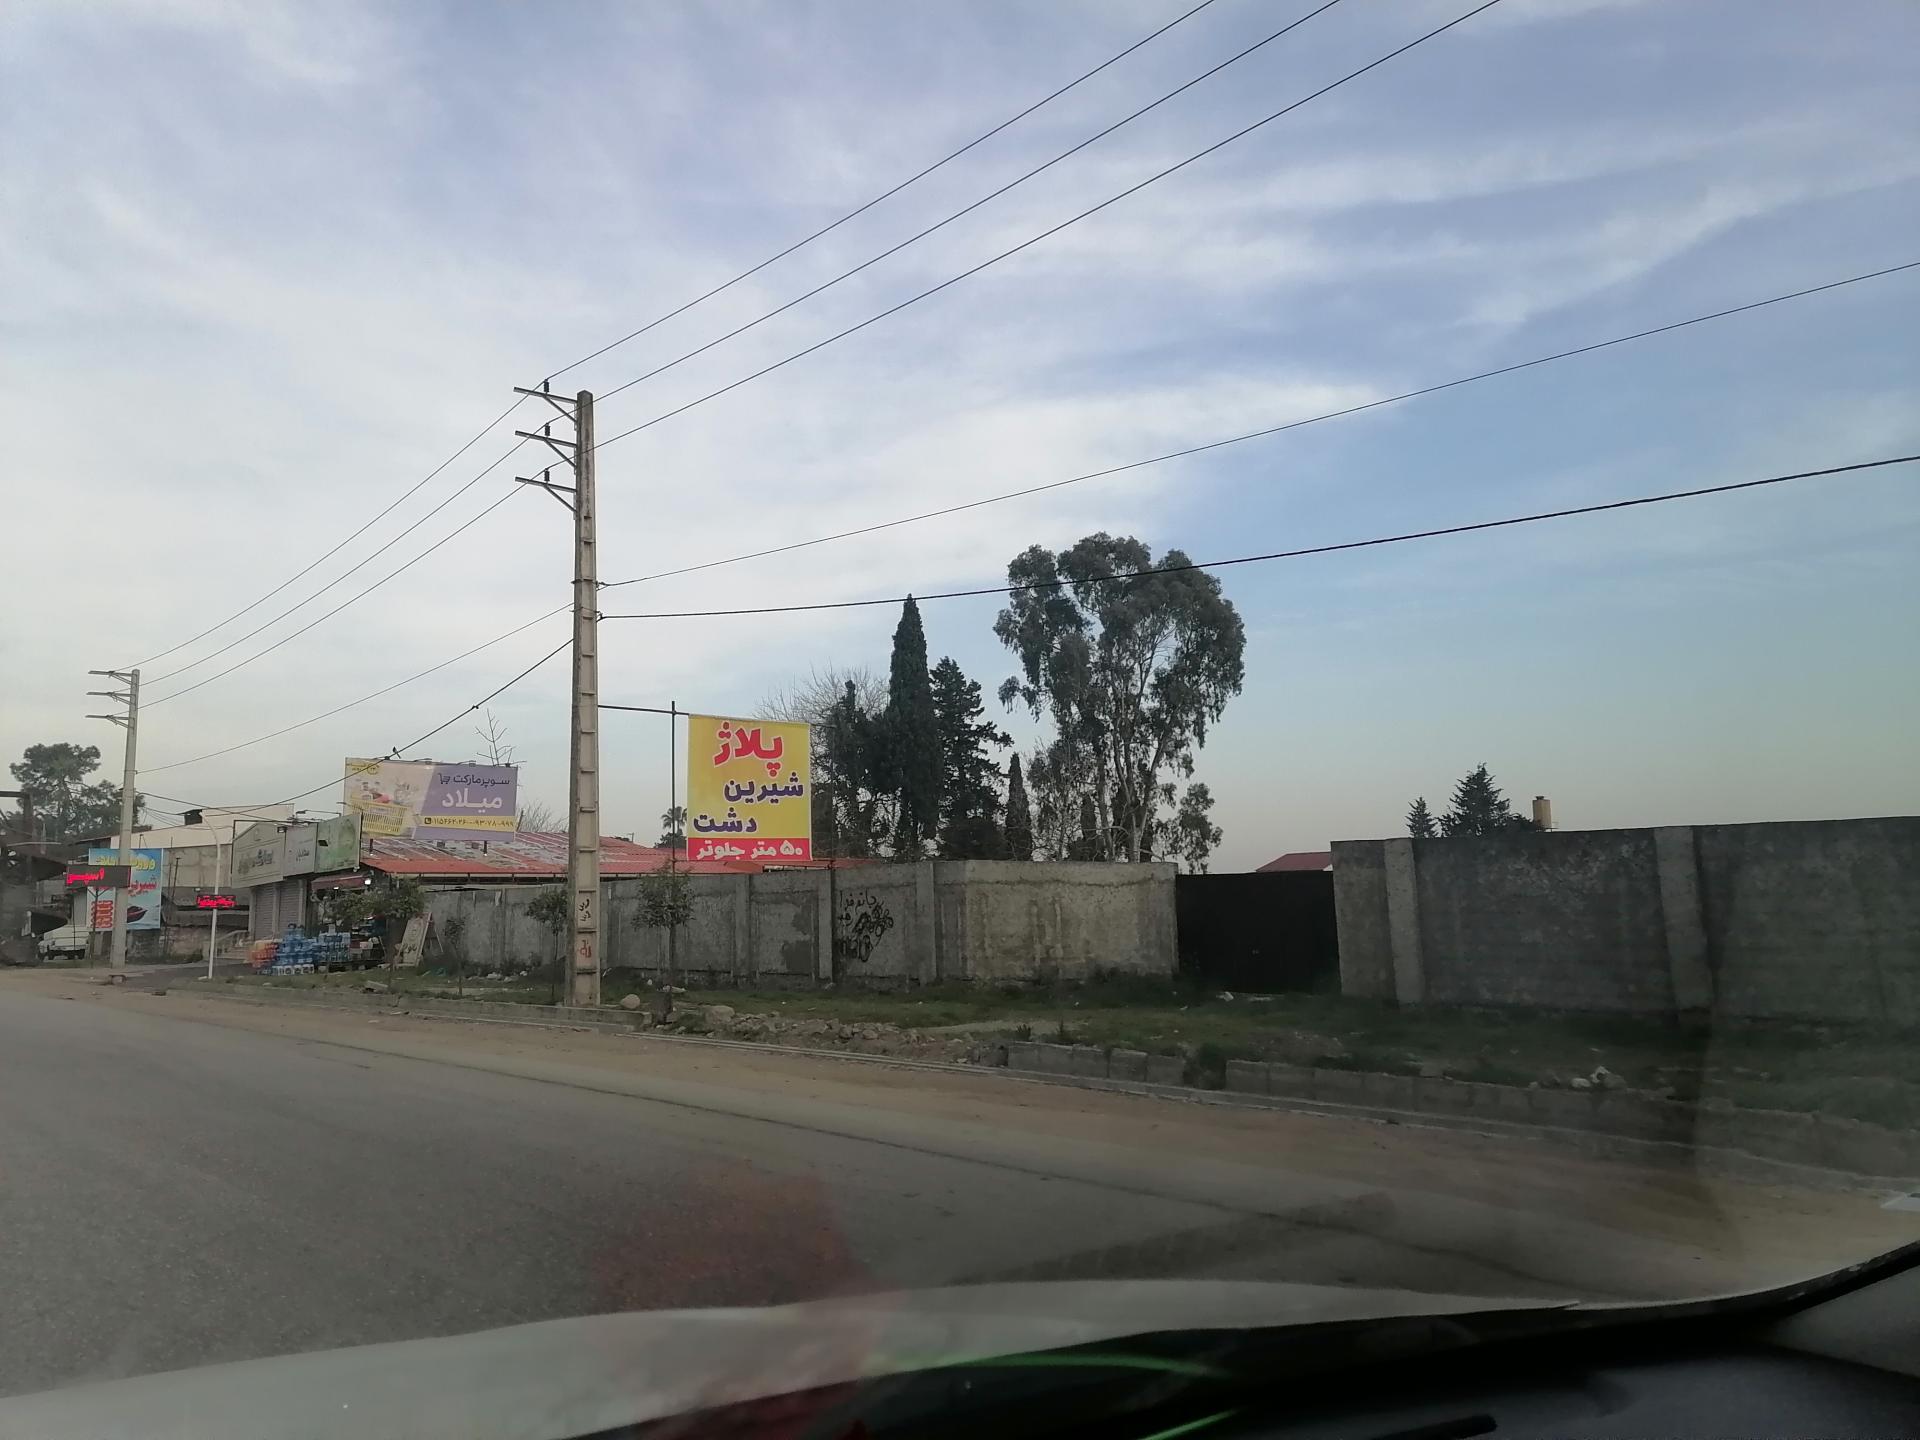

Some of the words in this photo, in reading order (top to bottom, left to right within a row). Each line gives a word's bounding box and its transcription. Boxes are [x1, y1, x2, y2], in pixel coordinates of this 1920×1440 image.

[714, 720, 783, 779] پلاژ
[453, 773, 510, 787] سوپرمارکت
[724, 771, 805, 803] شیرین
[442, 788, 503, 813] میلاد
[693, 805, 758, 834] دشت
[696, 840, 745, 861] جلوتر
[750, 841, 777, 859] متر
[780, 839, 803, 858] ۵۰
